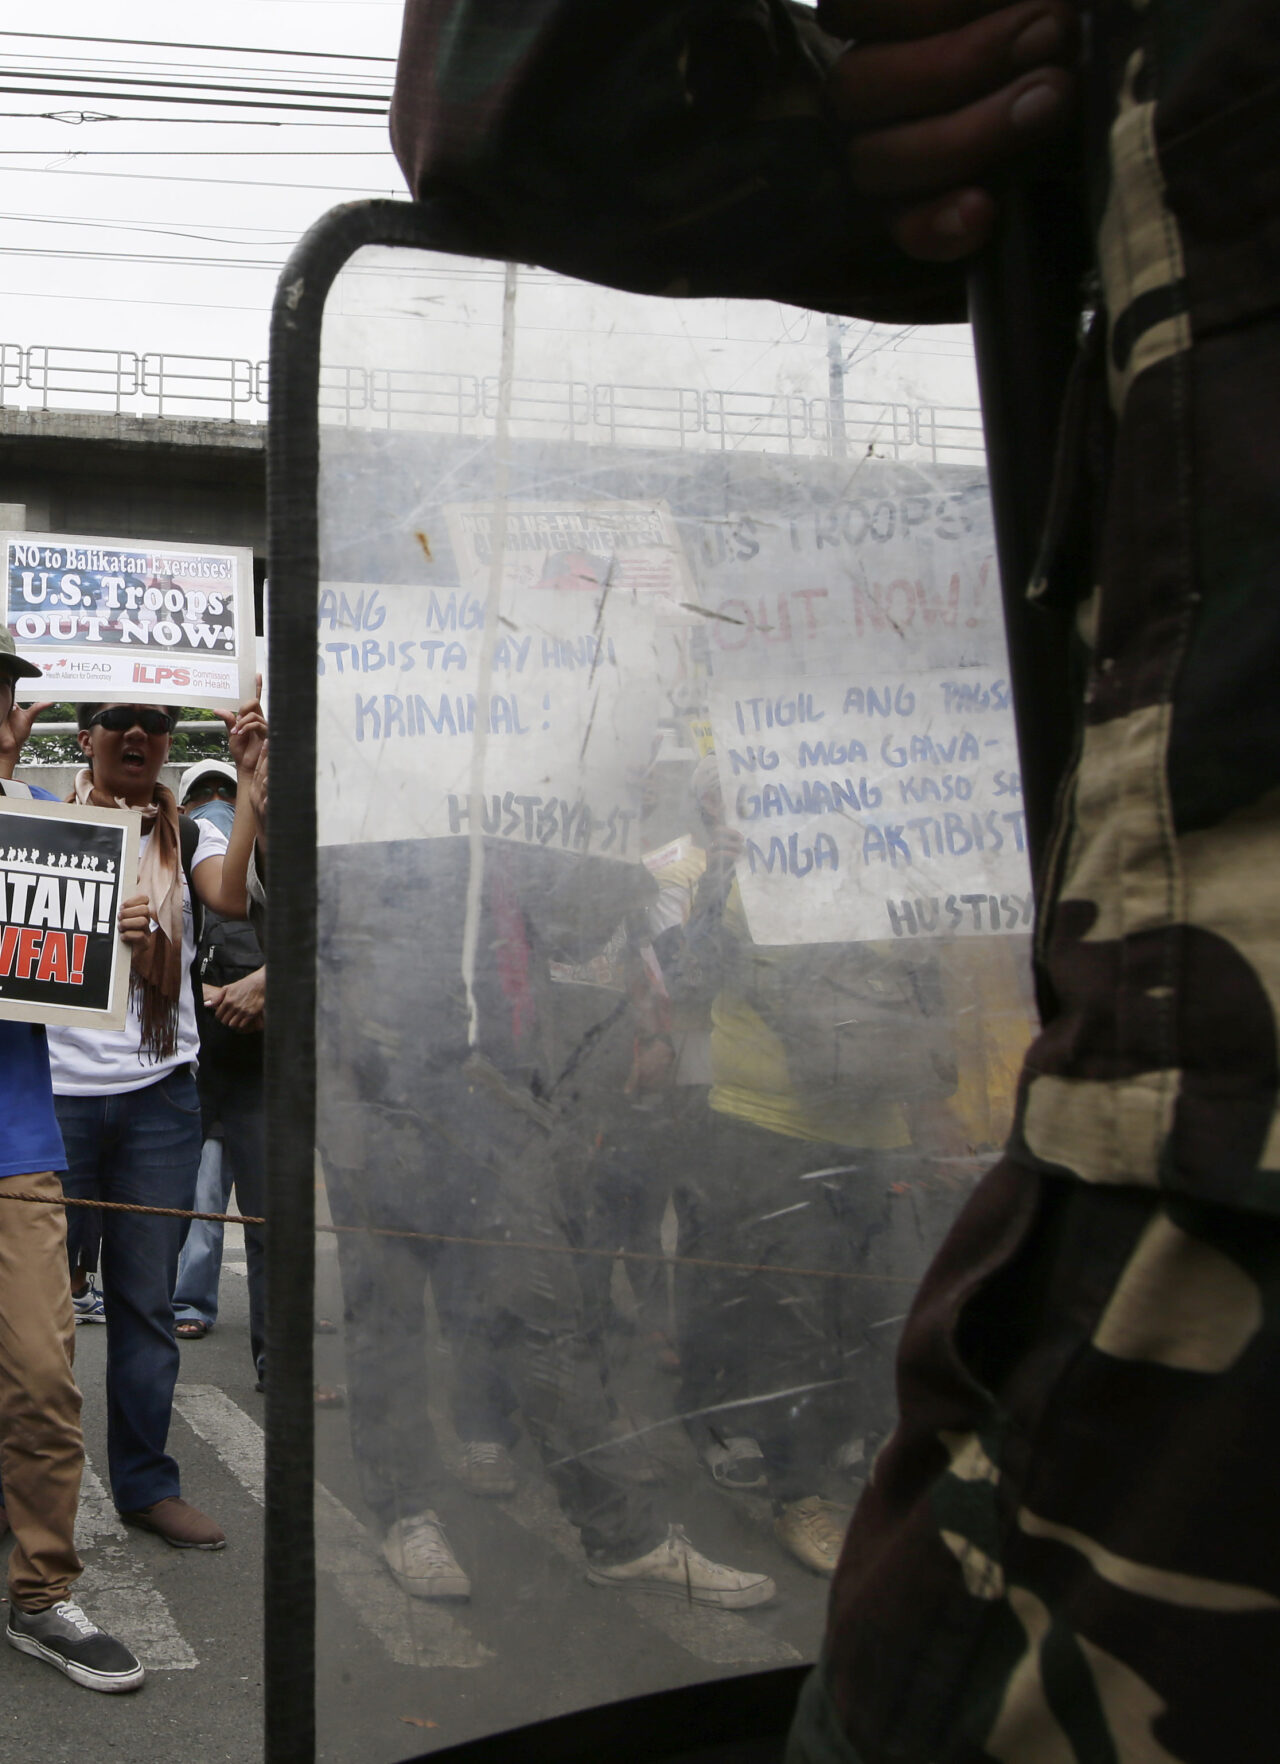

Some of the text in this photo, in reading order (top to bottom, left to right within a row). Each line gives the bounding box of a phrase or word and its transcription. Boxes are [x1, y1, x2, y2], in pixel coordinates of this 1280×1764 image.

[14, 545, 232, 579] NO to Balikatan Exercises!
[21, 571, 223, 621] U.S. Troops
[318, 588, 387, 632] ANG
[713, 554, 994, 652] OUT NOW!
[16, 613, 234, 650] OUT NOW!
[70, 662, 112, 672] HEAD
[492, 635, 532, 673] AY
[192, 668, 230, 679] Commission
[192, 679, 231, 690] on Health
[734, 692, 825, 735] ITIGIL
[843, 683, 916, 717] ANG
[729, 745, 780, 776] NG
[798, 738, 868, 770] MGA
[735, 777, 883, 821] GAWANG
[899, 774, 973, 805] KASO
[745, 831, 840, 879] MGA
